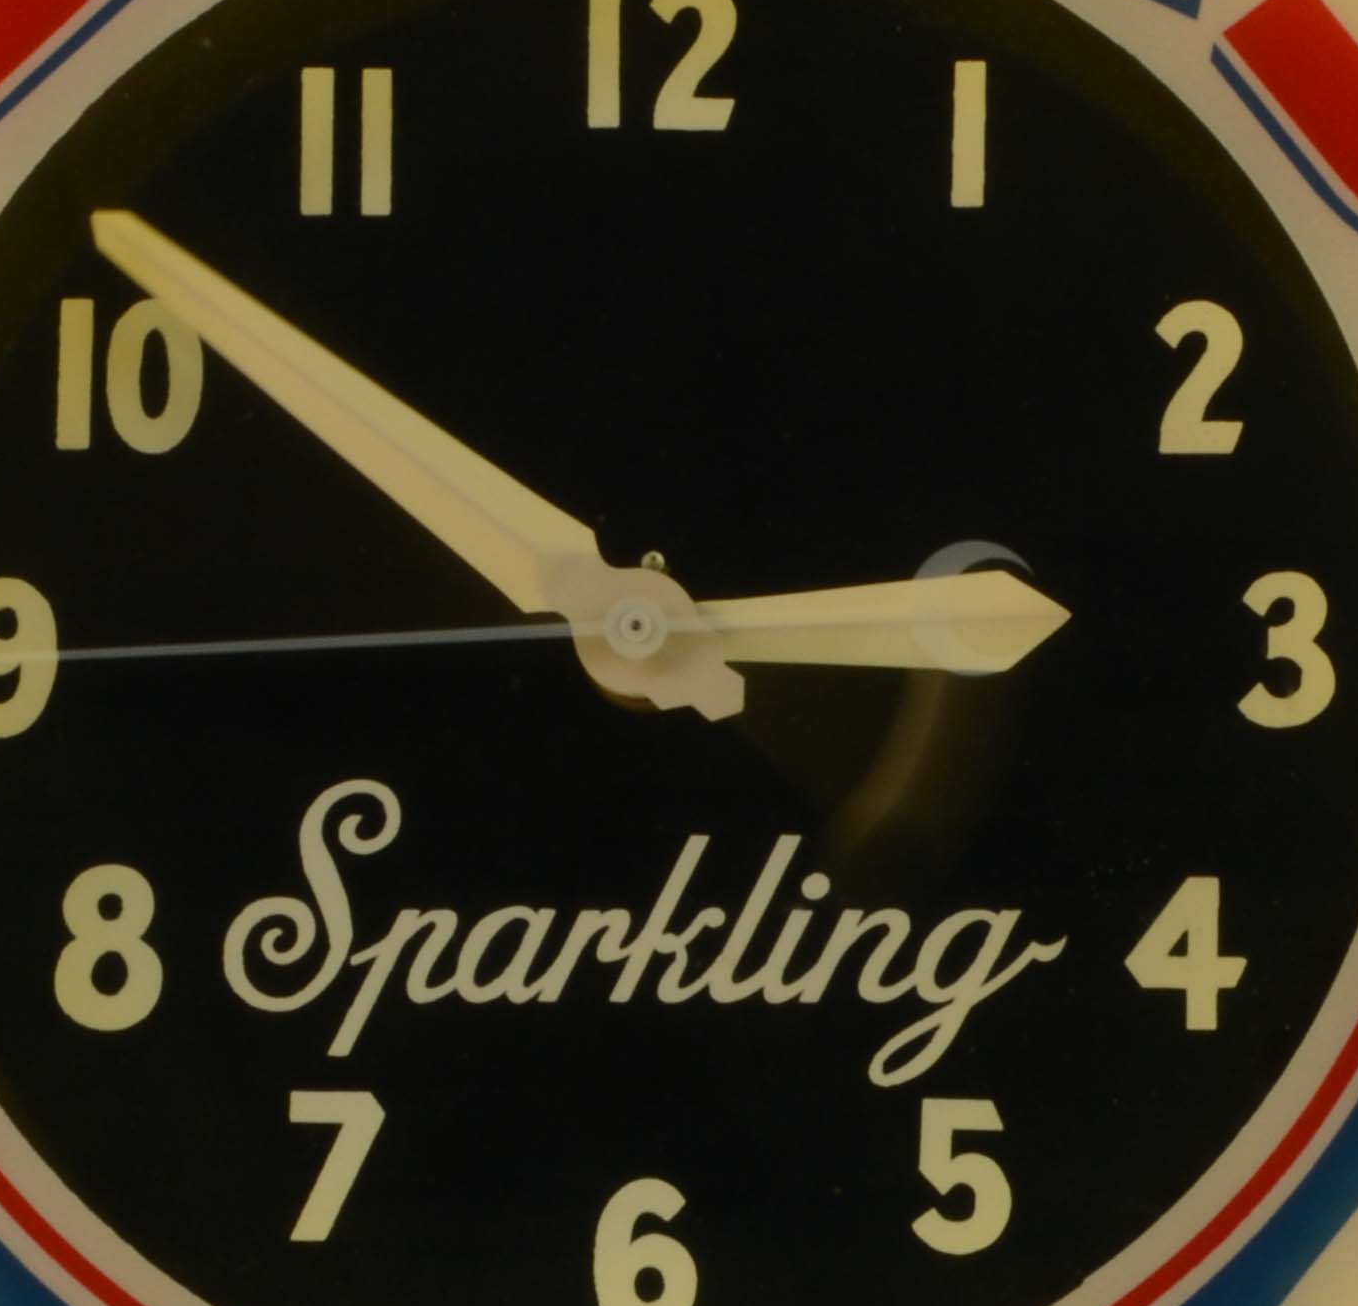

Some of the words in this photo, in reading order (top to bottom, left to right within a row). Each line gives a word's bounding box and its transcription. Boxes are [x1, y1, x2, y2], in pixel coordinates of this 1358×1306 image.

[300, 66, 393, 217] 11
[950, 60, 987, 208] 1
[55, 297, 205, 455] 10
[1154, 299, 1244, 455] 2
[1237, 570, 1336, 729] 3
[53, 863, 164, 1032] 8
[222, 777, 1067, 1088] Sparkling
[1124, 875, 1248, 1031] 4
[288, 1090, 386, 1242] 7
[911, 1097, 1013, 1256] 5
